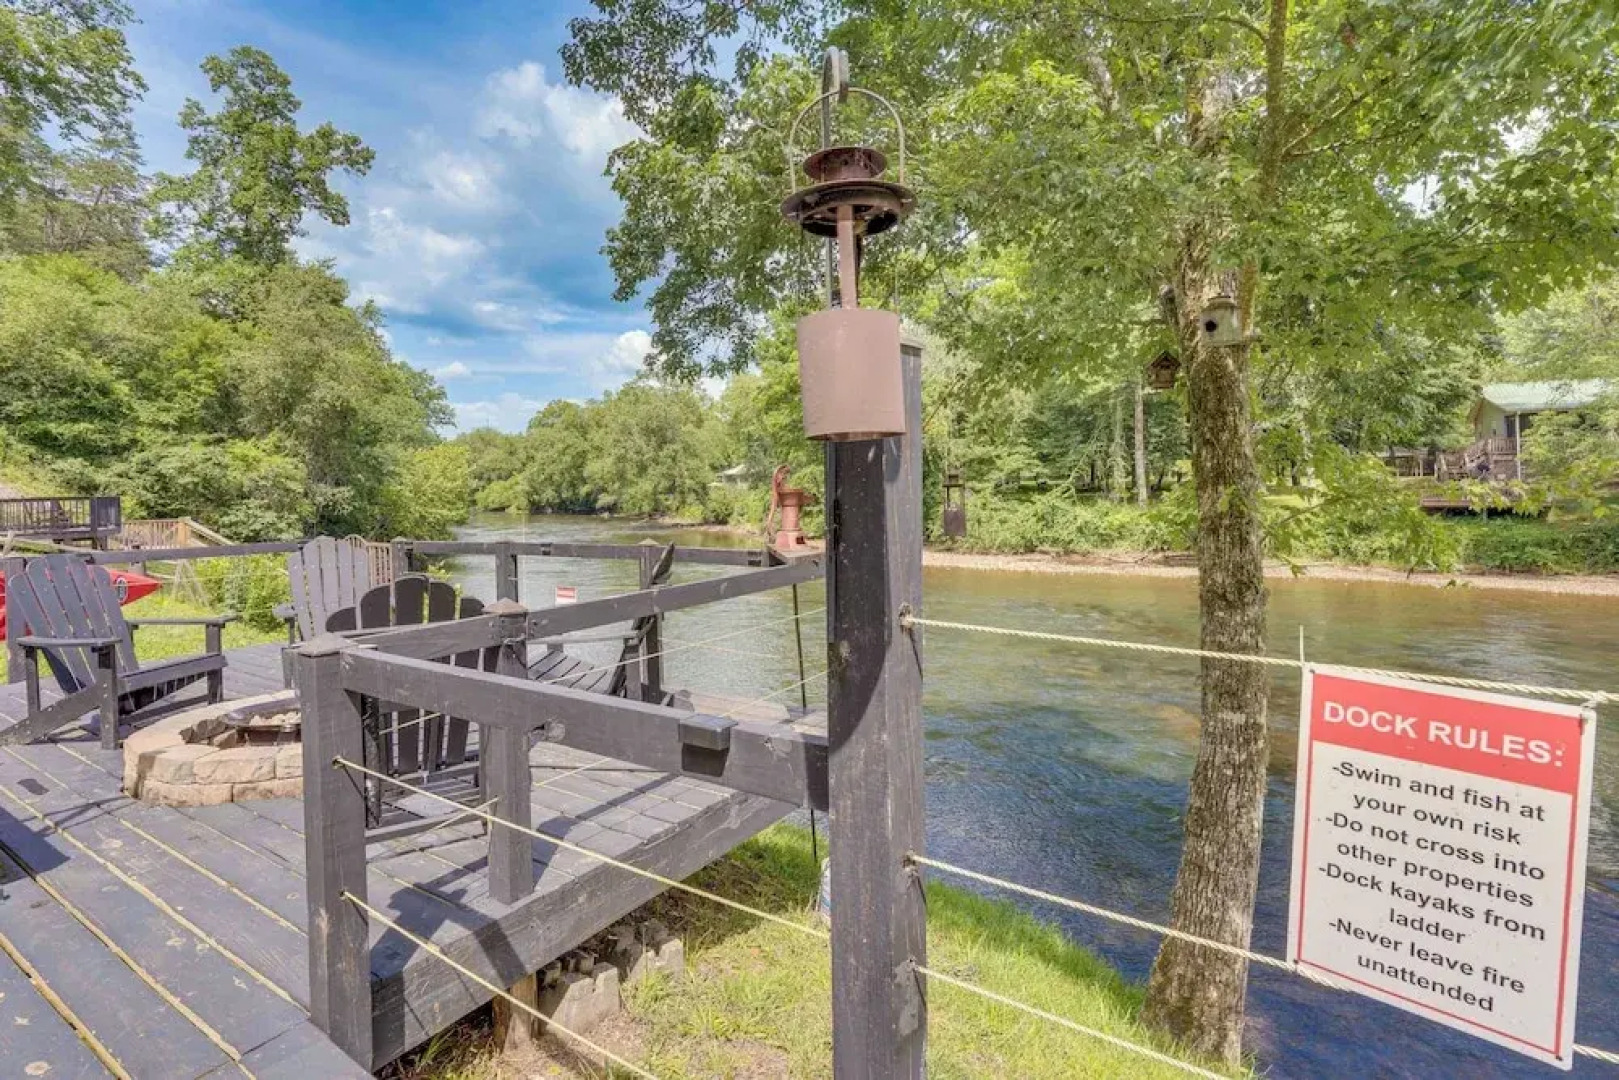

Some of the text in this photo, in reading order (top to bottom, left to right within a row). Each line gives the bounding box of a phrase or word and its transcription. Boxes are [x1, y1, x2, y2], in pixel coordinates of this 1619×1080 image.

[1323, 701, 1564, 767] DOCK RULES:
[1332, 762, 1545, 821] -Swim and fish at
[1353, 793, 1521, 845] your own risk
[1325, 813, 1545, 880] -Do not cross into
[1337, 843, 1533, 908] other properties
[1319, 862, 1545, 941] -Dock kayaks from
[1390, 908, 1465, 944] ladder
[1329, 919, 1525, 993] -Never leave fire
[1357, 954, 1493, 1012] unattended
